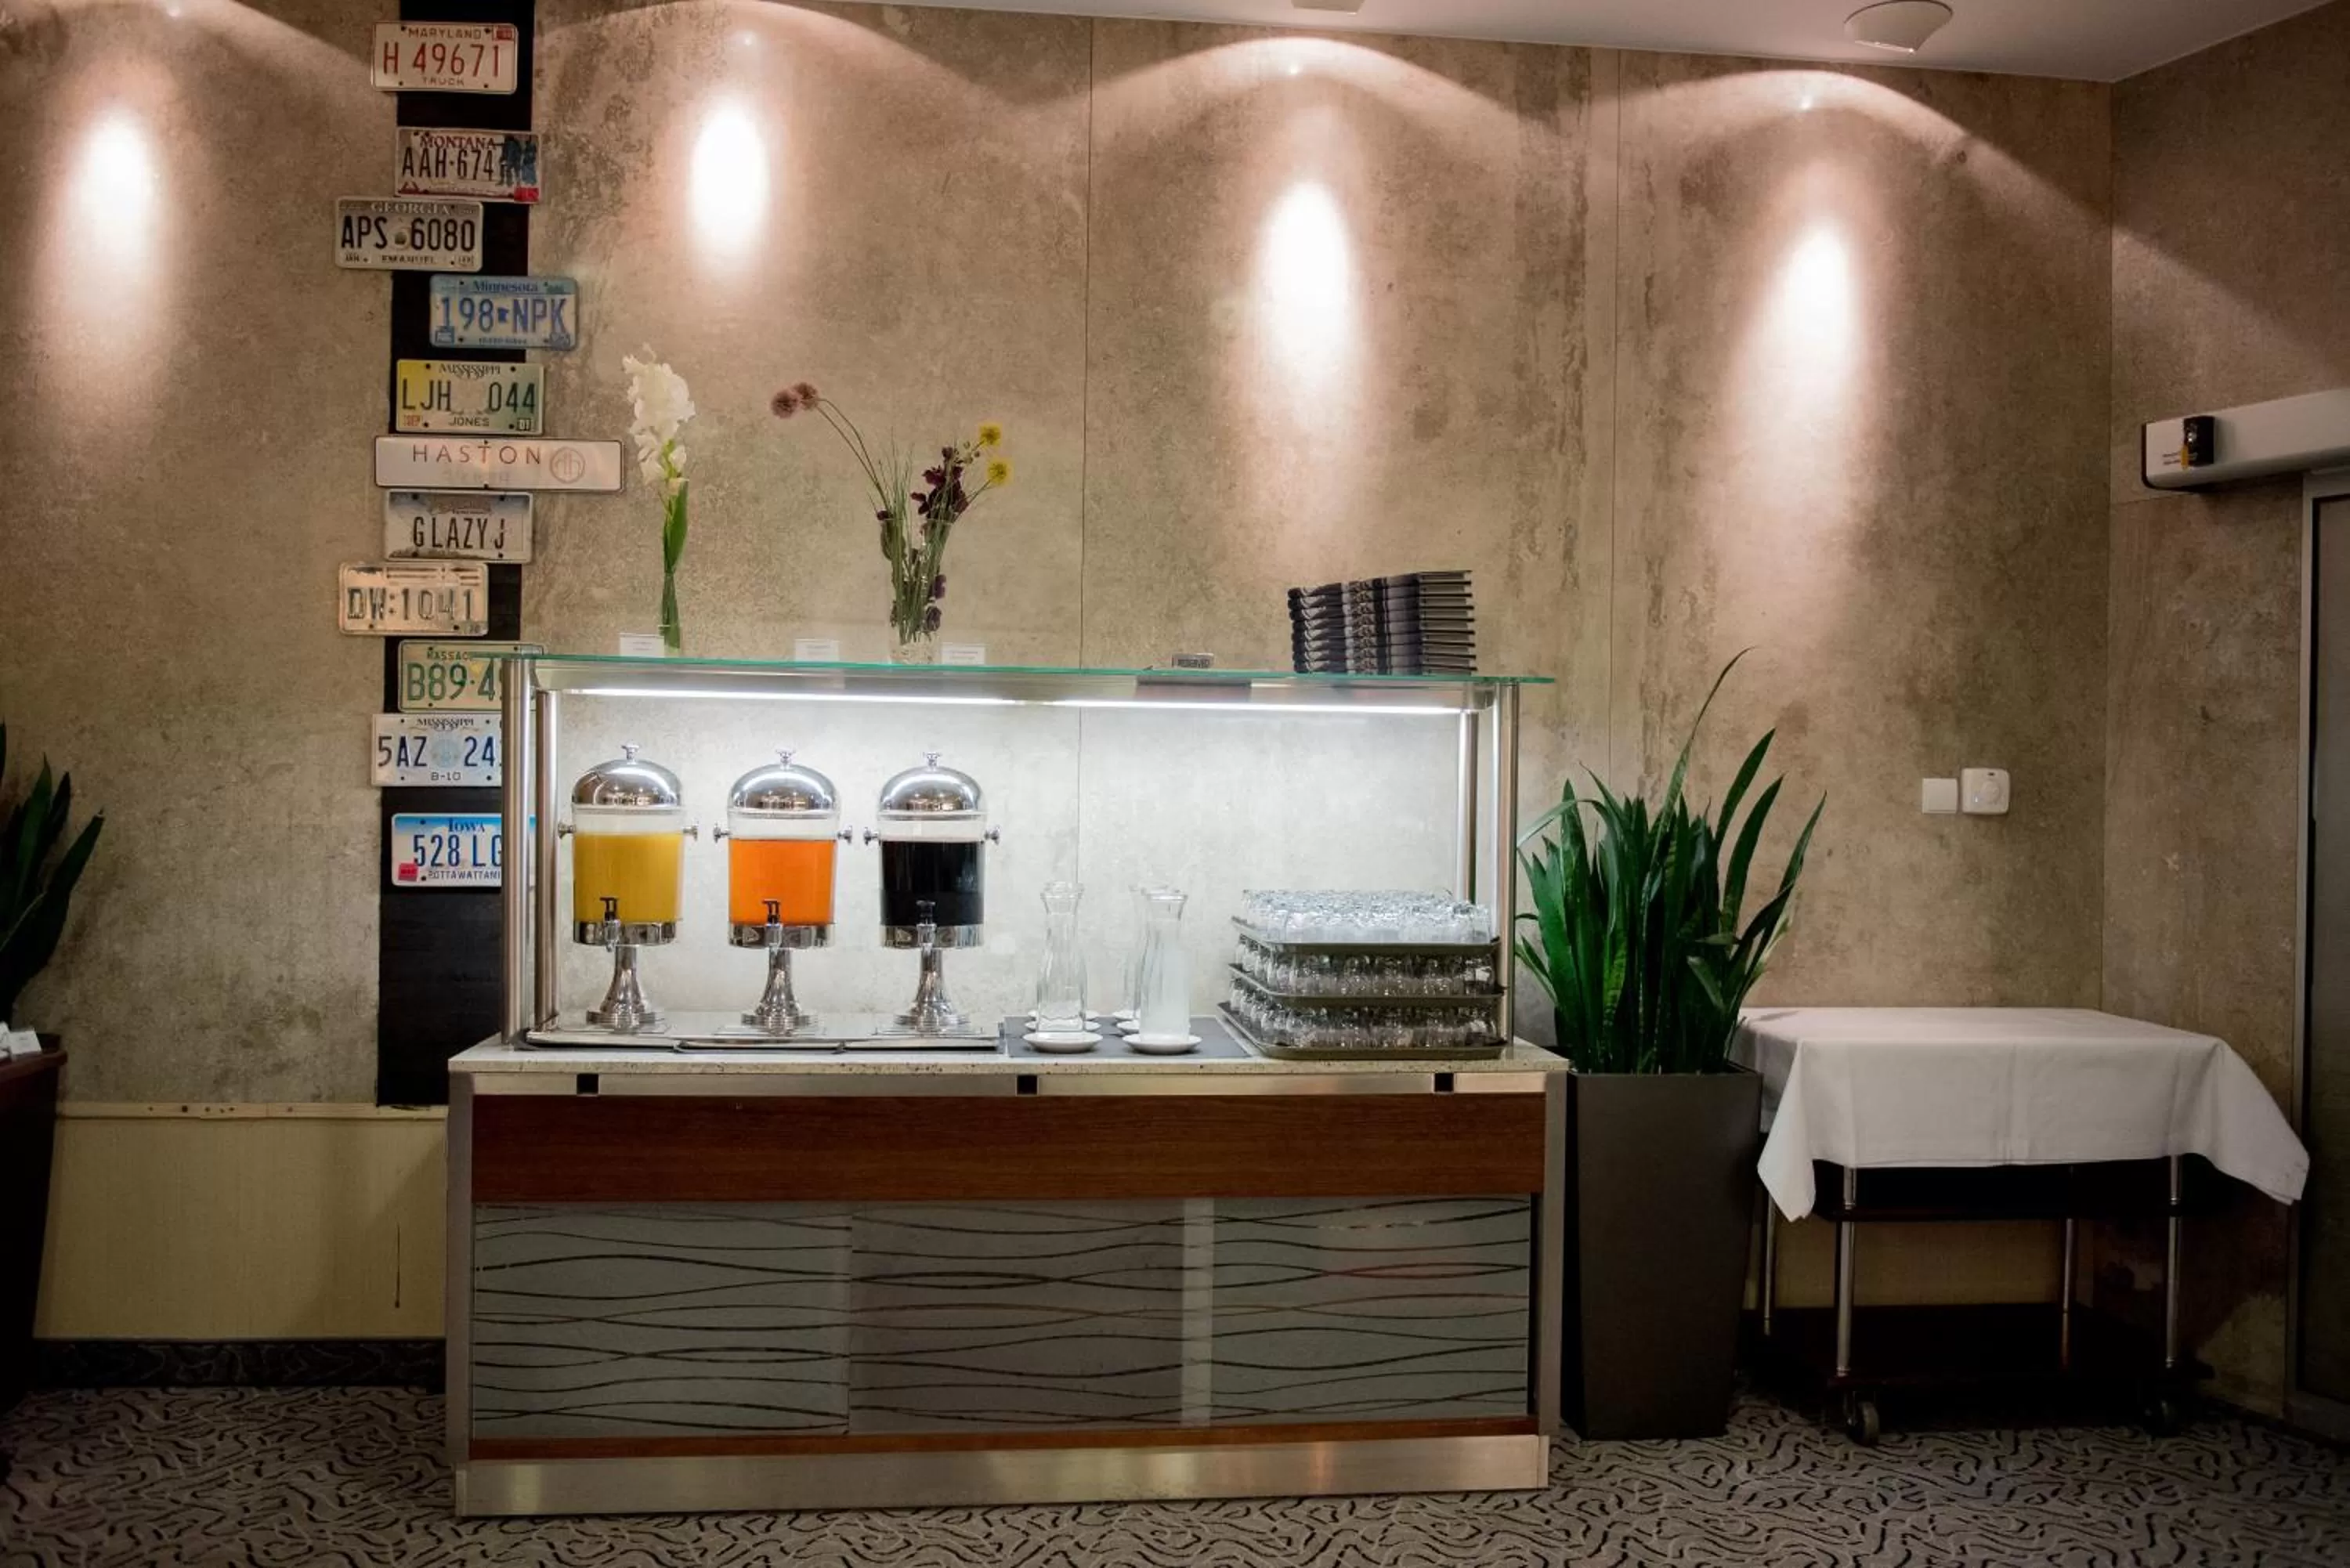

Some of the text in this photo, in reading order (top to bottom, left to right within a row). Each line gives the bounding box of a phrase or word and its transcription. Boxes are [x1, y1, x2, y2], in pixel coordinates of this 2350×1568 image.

[408, 27, 482, 39] MARYLAND
[383, 42, 499, 77] H 49671
[423, 78, 465, 86] TRUCK
[420, 134, 497, 150] MONTANA
[370, 201, 451, 215] GEORGIA
[341, 215, 475, 252] APS 6080
[472, 280, 539, 293] Minnesota
[402, 378, 536, 414] LJH 044
[449, 417, 490, 427] JONES
[413, 444, 541, 464] HASTON
[378, 735, 502, 768] 5AZ 24
[431, 771, 461, 781] B-10
[413, 834, 501, 867] 528 LG
[428, 870, 501, 880] POTTAWATTAMI
